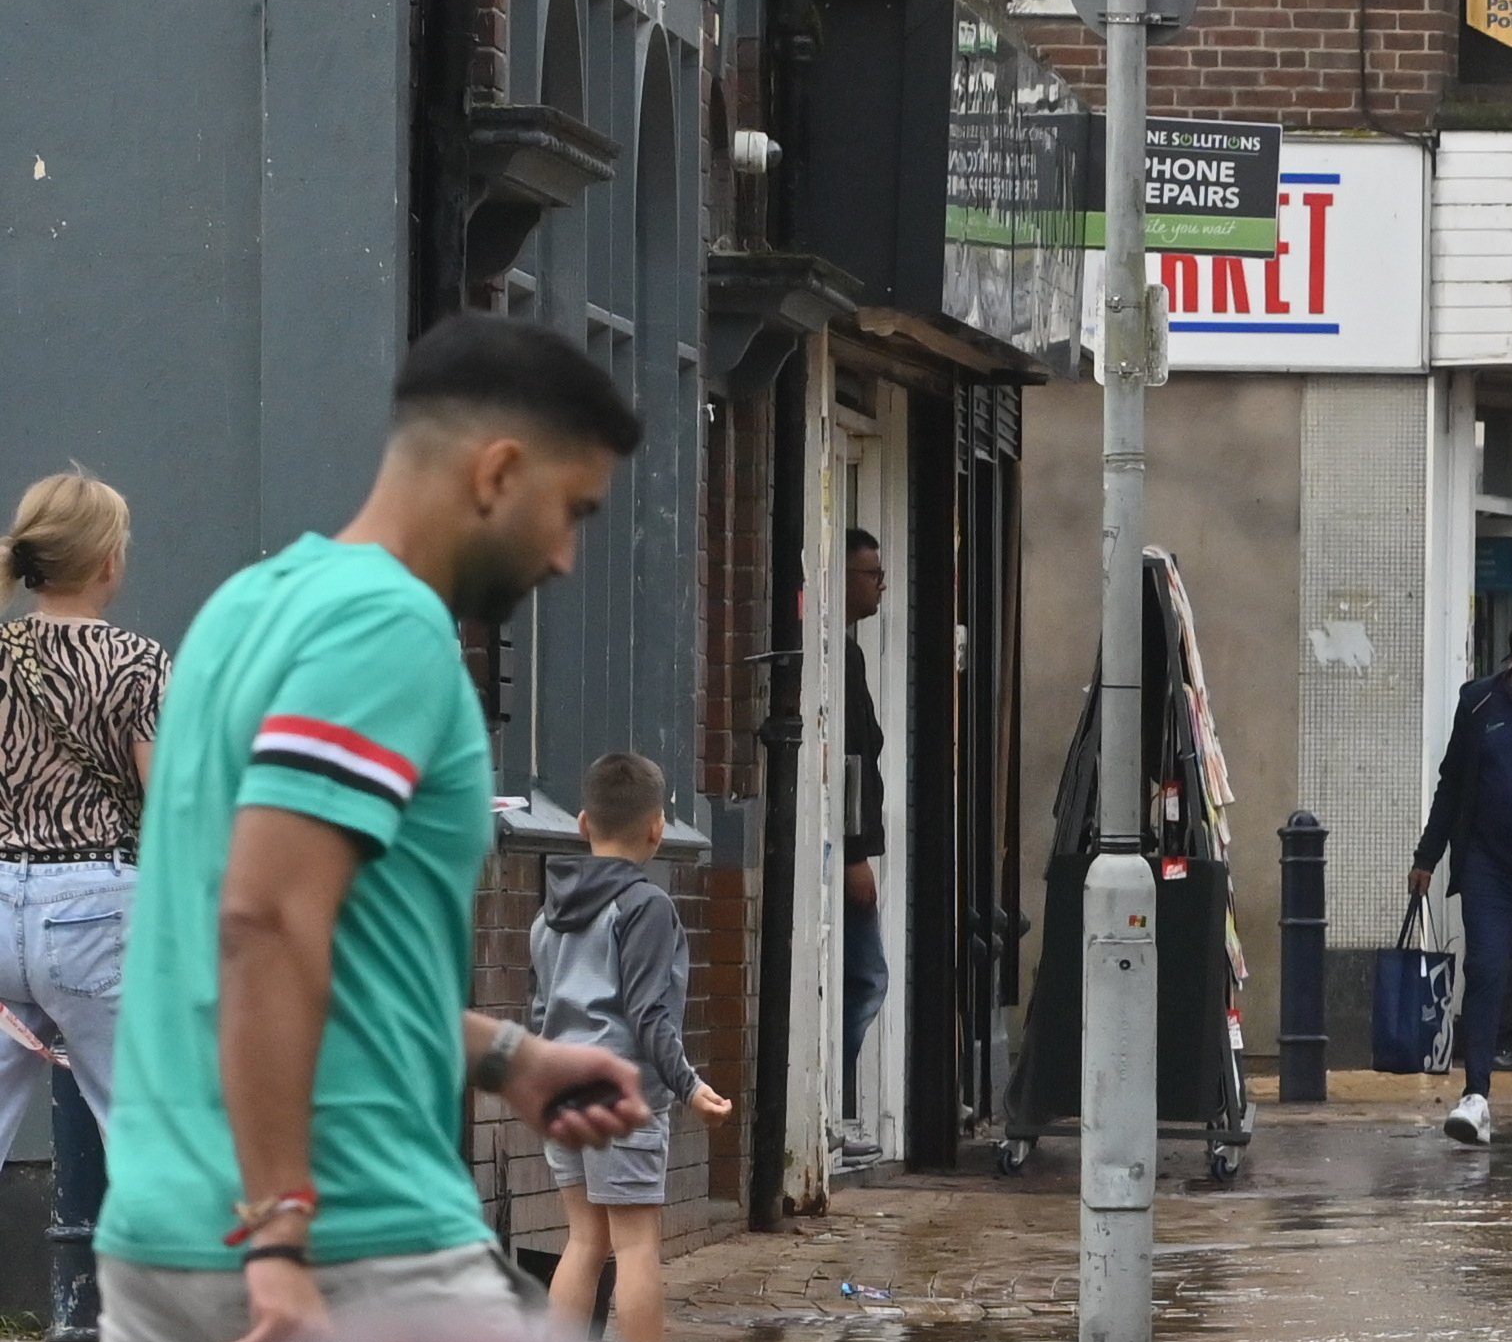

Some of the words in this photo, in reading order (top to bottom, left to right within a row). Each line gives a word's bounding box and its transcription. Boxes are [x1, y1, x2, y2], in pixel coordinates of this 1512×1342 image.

[1146, 157, 1236, 184] HONE
[1146, 182, 1241, 209] EPAIRS
[1170, 220, 1201, 244] you
[1200, 220, 1237, 236] wait
